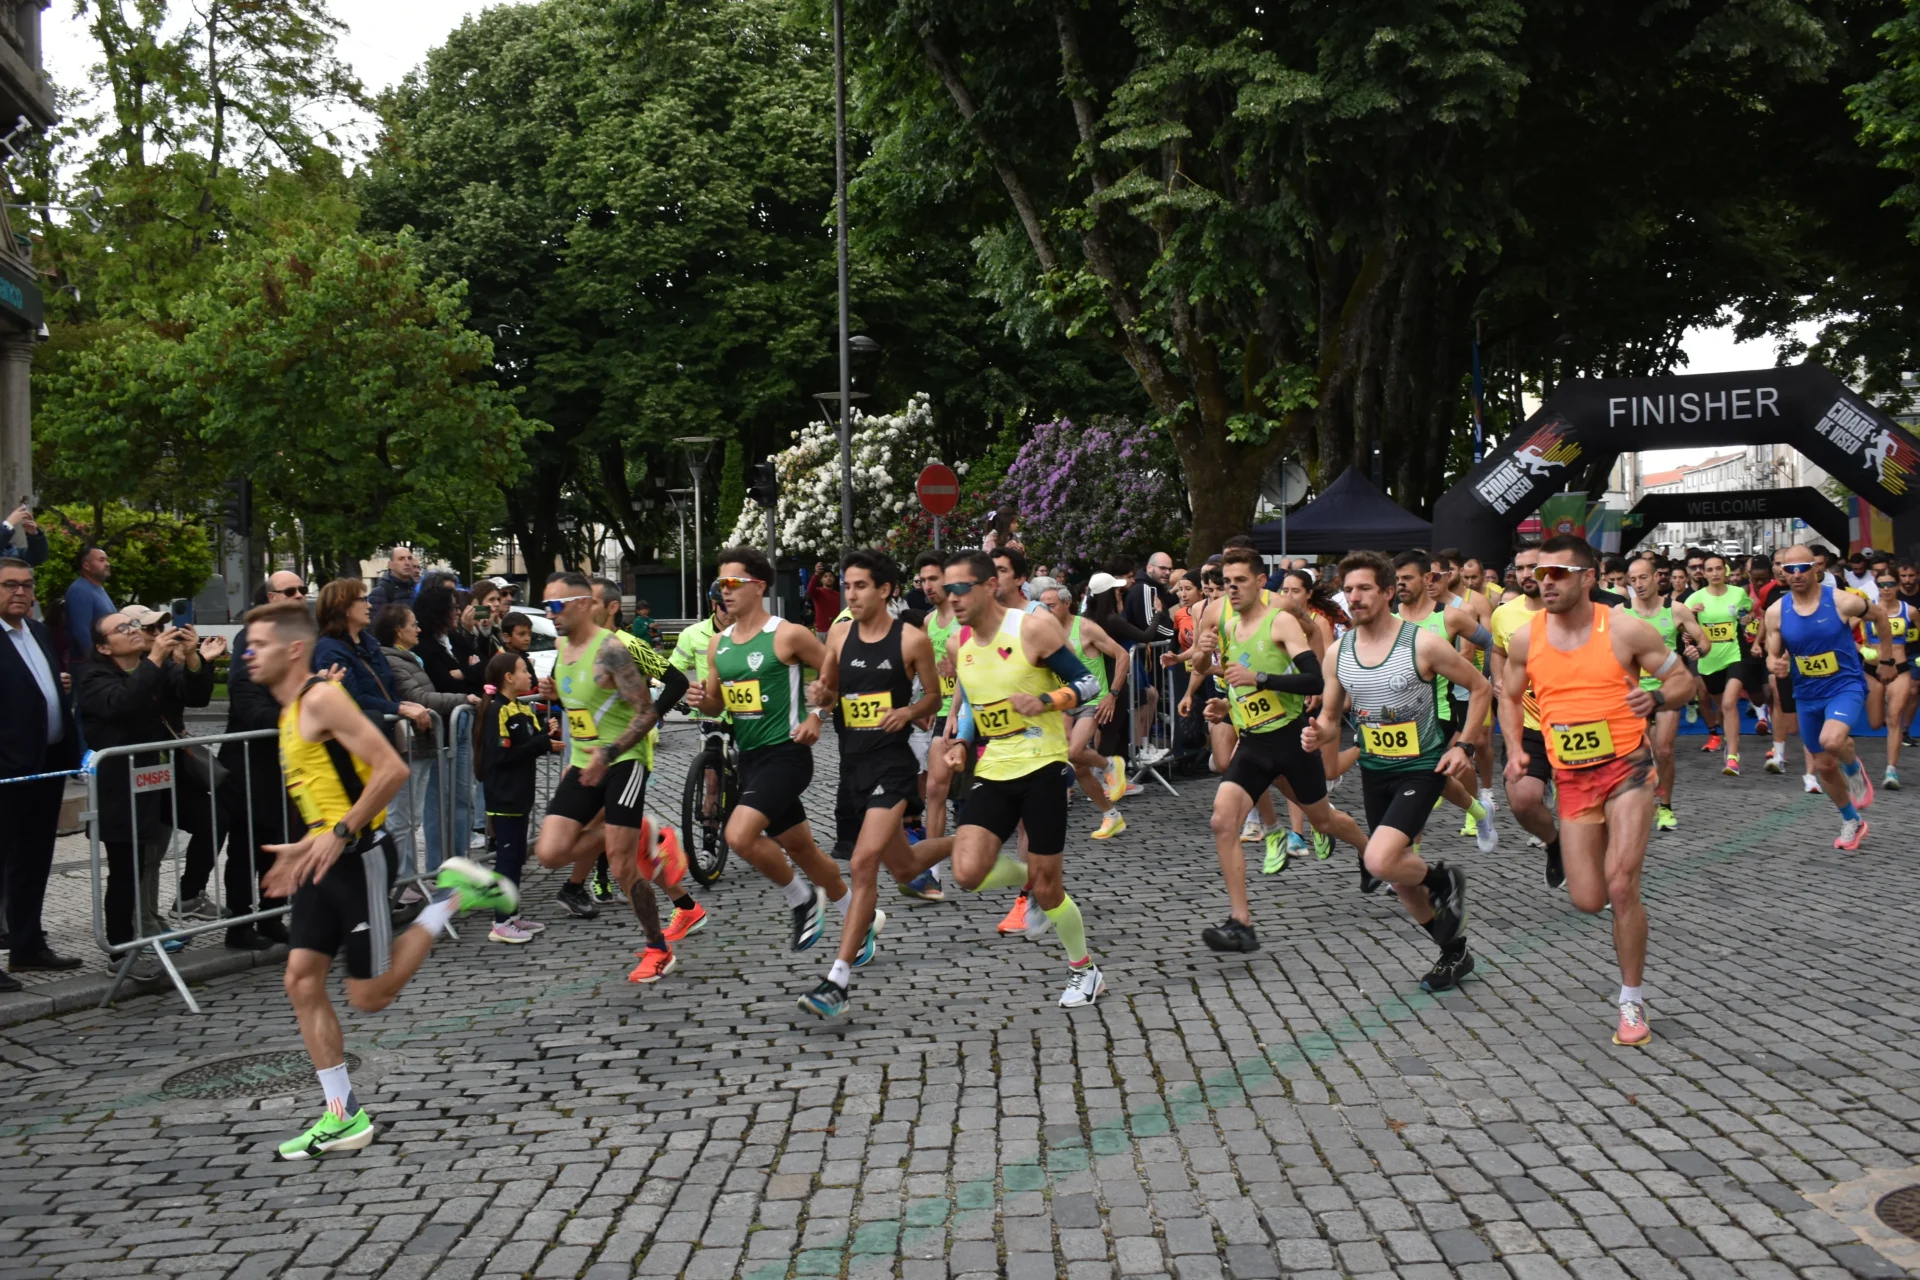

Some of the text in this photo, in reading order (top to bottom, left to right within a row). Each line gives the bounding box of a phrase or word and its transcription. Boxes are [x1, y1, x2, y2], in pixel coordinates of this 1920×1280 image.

[1609, 387, 1780, 428] FINISHER
[1827, 401, 1876, 441] CIDADE
[1814, 416, 1863, 455] DE VISEU
[1479, 462, 1524, 503] CIDADE
[1492, 476, 1535, 515] DE VISEU
[1687, 498, 1767, 515] WELCOME
[1709, 627, 1727, 637] 159
[1803, 658, 1828, 671] 241
[728, 688, 753, 704] 066
[850, 700, 881, 719] 337
[1244, 697, 1271, 718] 198
[980, 708, 1010, 729] 027
[1371, 730, 1408, 748] 308
[1560, 730, 1600, 752] 225
[136, 769, 171, 788] CMSPS
